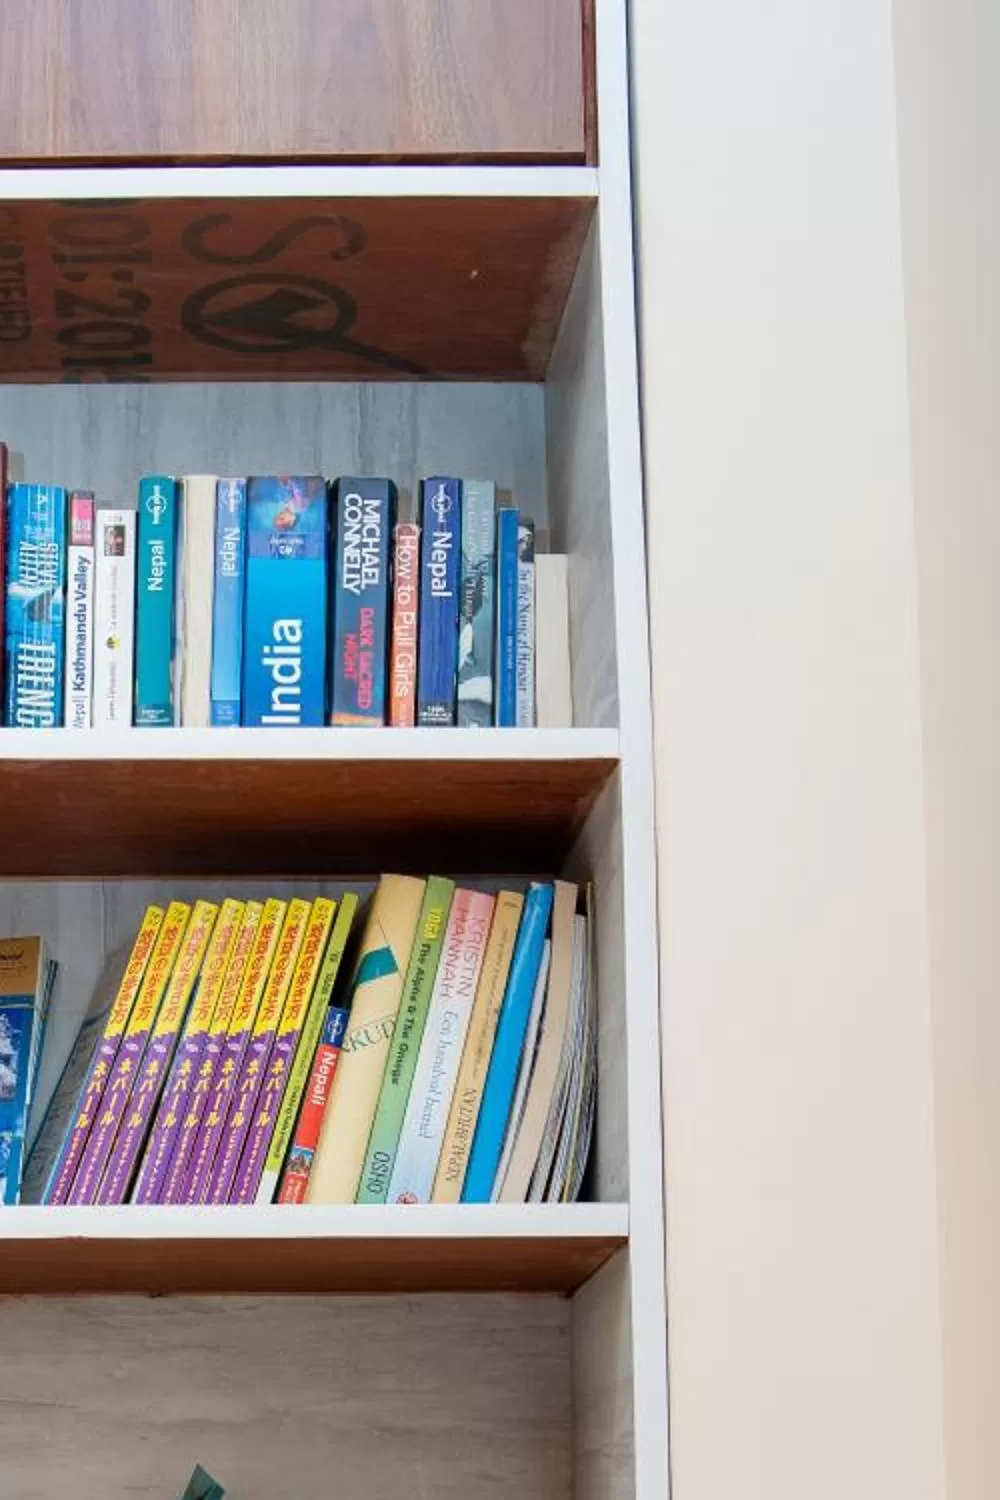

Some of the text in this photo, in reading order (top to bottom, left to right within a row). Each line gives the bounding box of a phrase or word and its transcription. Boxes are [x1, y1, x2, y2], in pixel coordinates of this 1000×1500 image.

[147, 539, 167, 591] Nepal
[222, 527, 240, 577] Nepal
[343, 493, 362, 596] CONNELLY
[361, 499, 381, 589] MICHAEL
[398, 535, 418, 581] How
[427, 531, 453, 597] Nepal
[74, 555, 91, 601] Valley
[398, 585, 415, 605] to
[398, 612, 416, 647] Pull
[517, 604, 532, 636] Name
[73, 605, 87, 691] Kathmandu
[261, 618, 302, 725] India
[344, 633, 357, 680] NIGHT
[357, 607, 374, 709] DARK SACRED
[395, 653, 413, 697] Girls
[440, 907, 470, 999] HANNAH
[456, 916, 487, 998] KRISTIN
[311, 1052, 337, 1105] Nepali
[366, 1151, 391, 1195] OSHO
